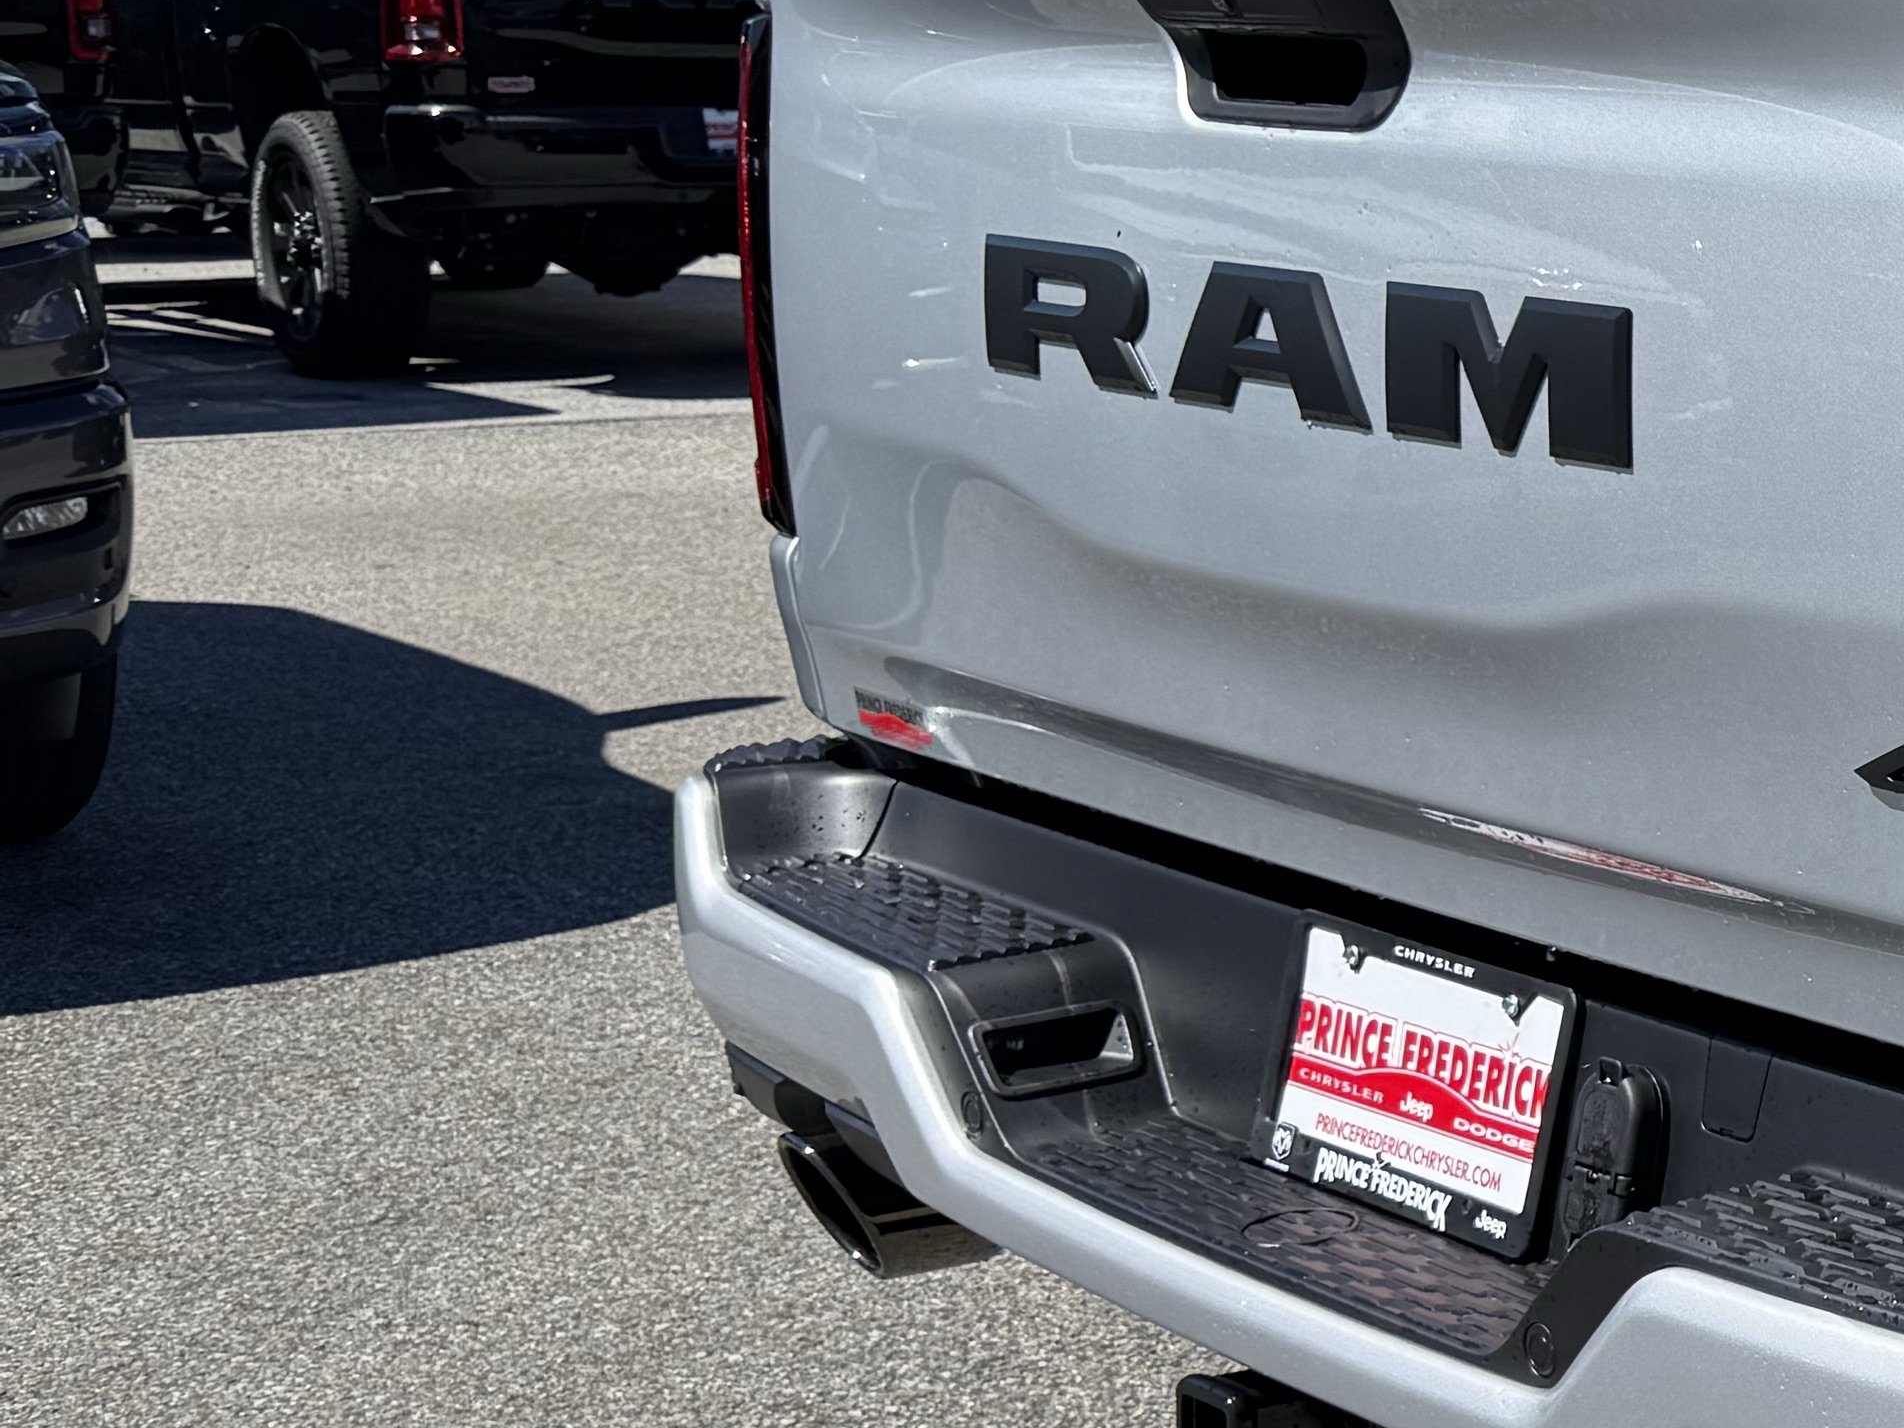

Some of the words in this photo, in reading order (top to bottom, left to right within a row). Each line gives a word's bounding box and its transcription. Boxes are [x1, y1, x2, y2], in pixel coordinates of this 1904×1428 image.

[983, 232, 1633, 474] RAM
[1393, 945, 1476, 979] CHRYSLER
[1295, 998, 1394, 1069] PRINCE
[1401, 1029, 1550, 1119] FREDERICK
[1299, 1067, 1384, 1104] CHRYSLER
[1399, 1091, 1434, 1123] Jeep
[1453, 1116, 1536, 1152] DODGE
[1315, 1112, 1503, 1193] PRINCEFREDERICKCHRYSLER.COM
[1313, 1146, 1370, 1189] PRINCE
[1369, 1169, 1453, 1232] FREDERICK
[1474, 1209, 1508, 1240] Jeep
